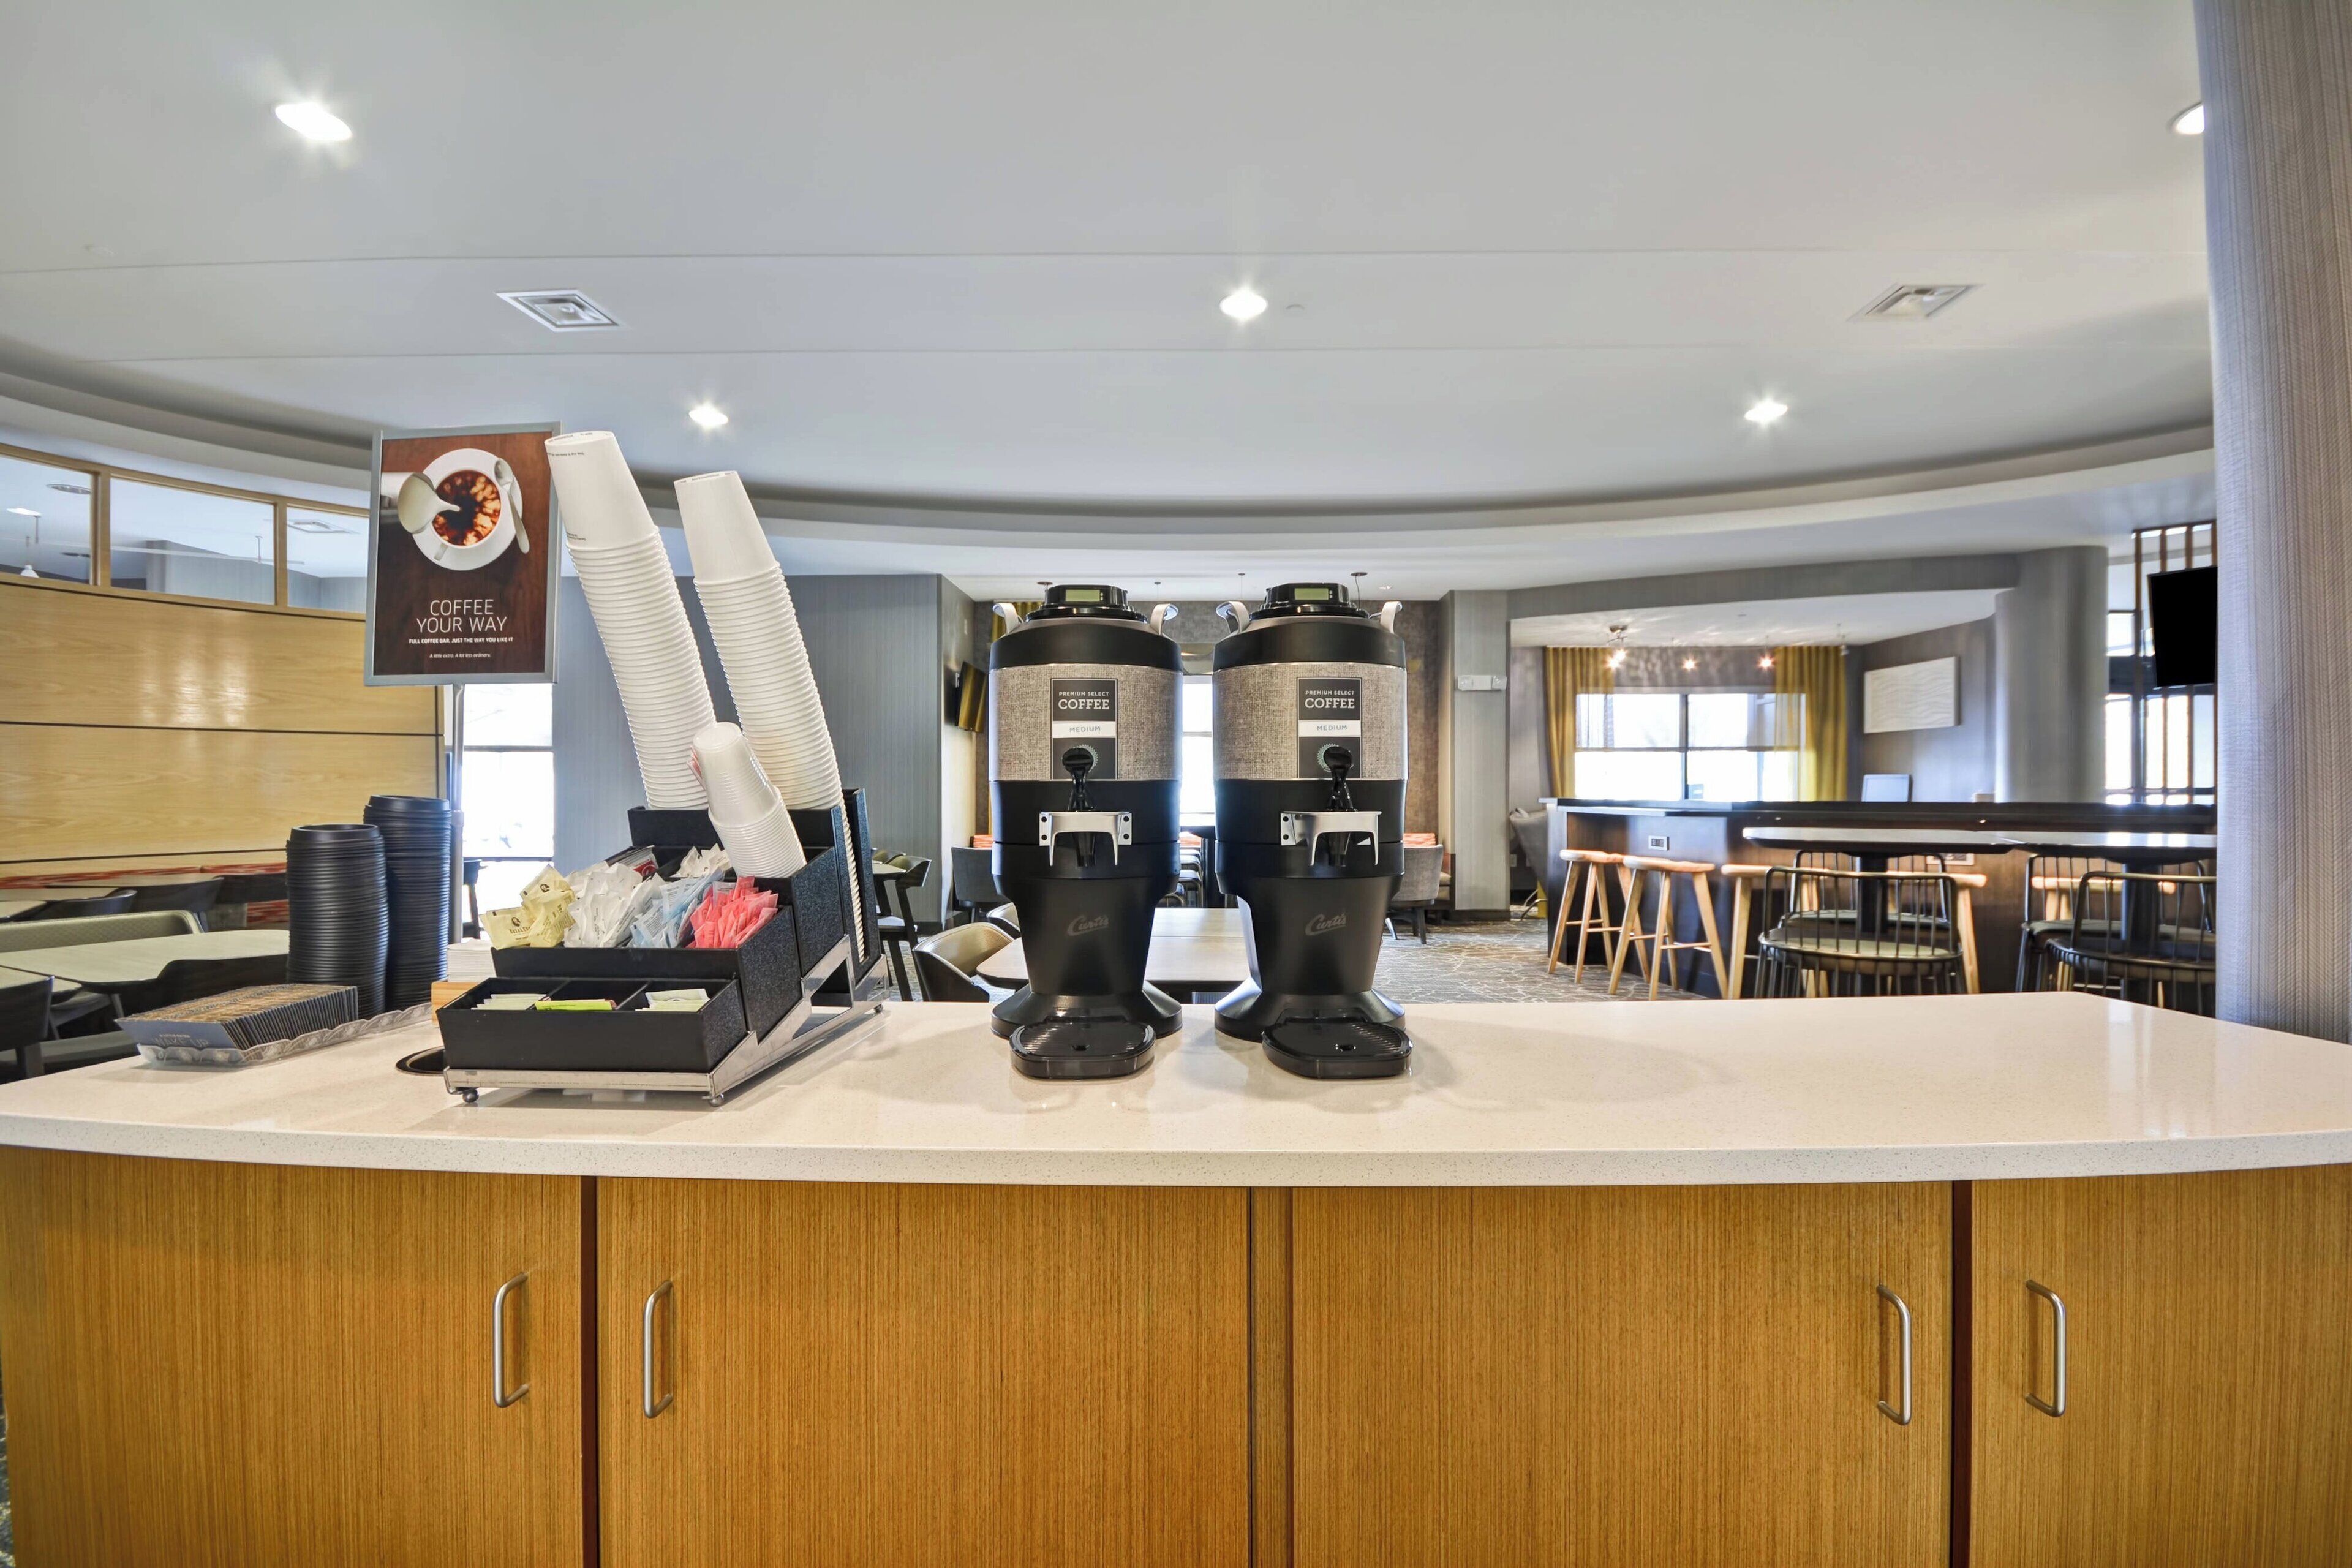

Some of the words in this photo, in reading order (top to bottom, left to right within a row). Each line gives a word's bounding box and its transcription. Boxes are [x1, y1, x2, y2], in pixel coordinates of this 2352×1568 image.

[430, 599, 494, 616] COFFEE
[417, 617, 462, 633] YOUR
[469, 616, 507, 633] WAY
[1058, 699, 1110, 709] COFFEE
[1305, 698, 1355, 709] COFFEE
[1068, 914, 1109, 936] Curtis
[1305, 913, 1346, 936] Curtis
